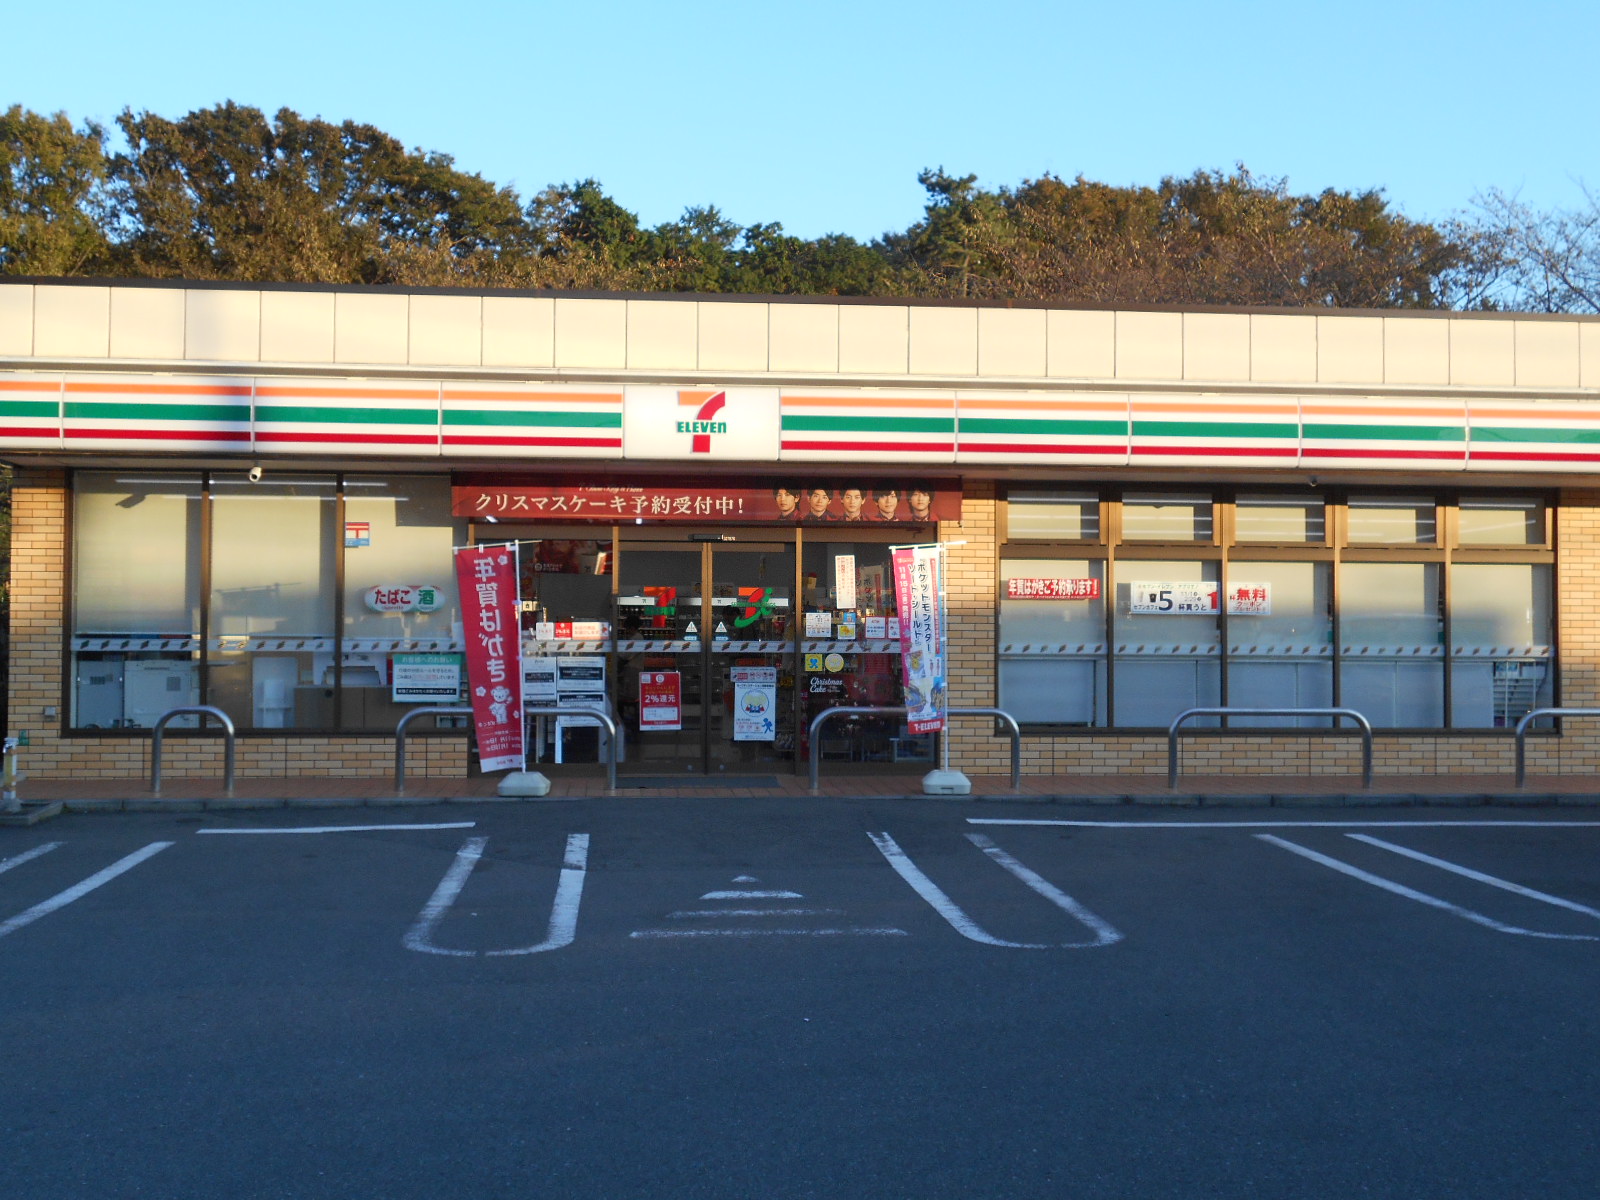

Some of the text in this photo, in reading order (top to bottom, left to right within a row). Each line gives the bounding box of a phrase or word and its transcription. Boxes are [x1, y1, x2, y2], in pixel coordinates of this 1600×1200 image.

[677, 391, 726, 453] 7
[475, 493, 744, 515] クリスマスケーキ予約受付中!
[374, 589, 435, 605] たばこ 酒
[1158, 591, 1174, 611] 5
[1237, 588, 1267, 602] 無料
[810, 677, 843, 686] Christmas
[810, 684, 827, 693] Cake
[644, 694, 676, 703] 2%還元
